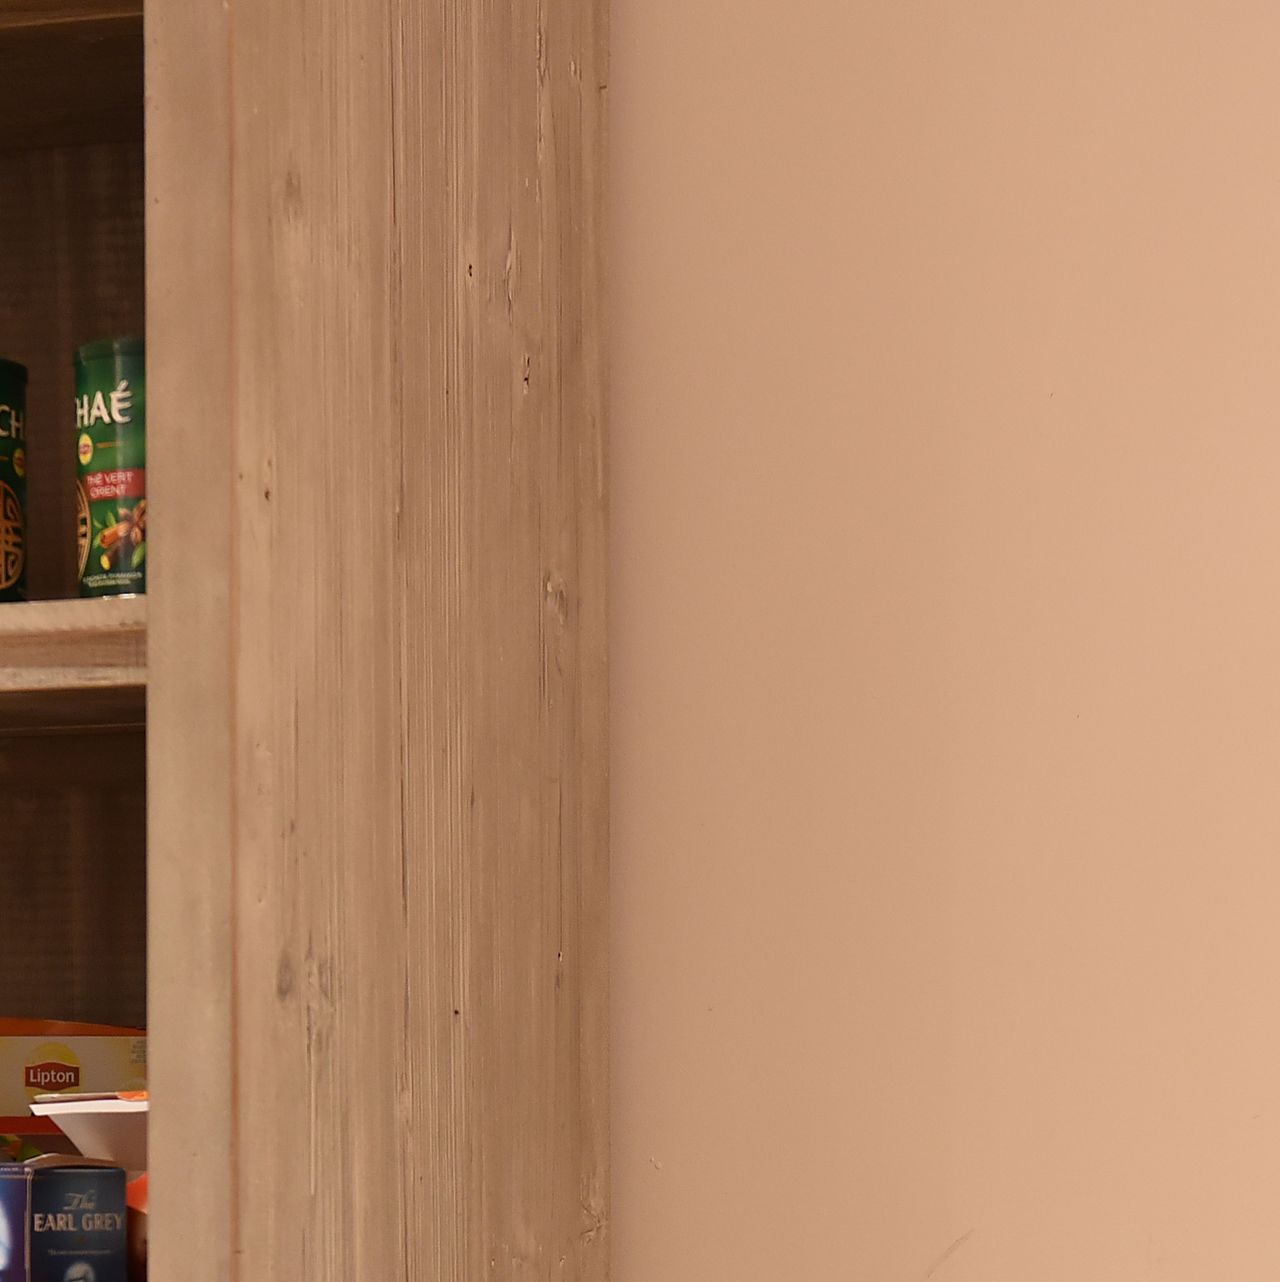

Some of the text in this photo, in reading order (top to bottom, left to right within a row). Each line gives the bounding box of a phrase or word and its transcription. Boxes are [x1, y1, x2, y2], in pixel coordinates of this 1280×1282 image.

[29, 1068, 75, 1084] Lipton
[33, 1213, 122, 1232] EARL GREY
